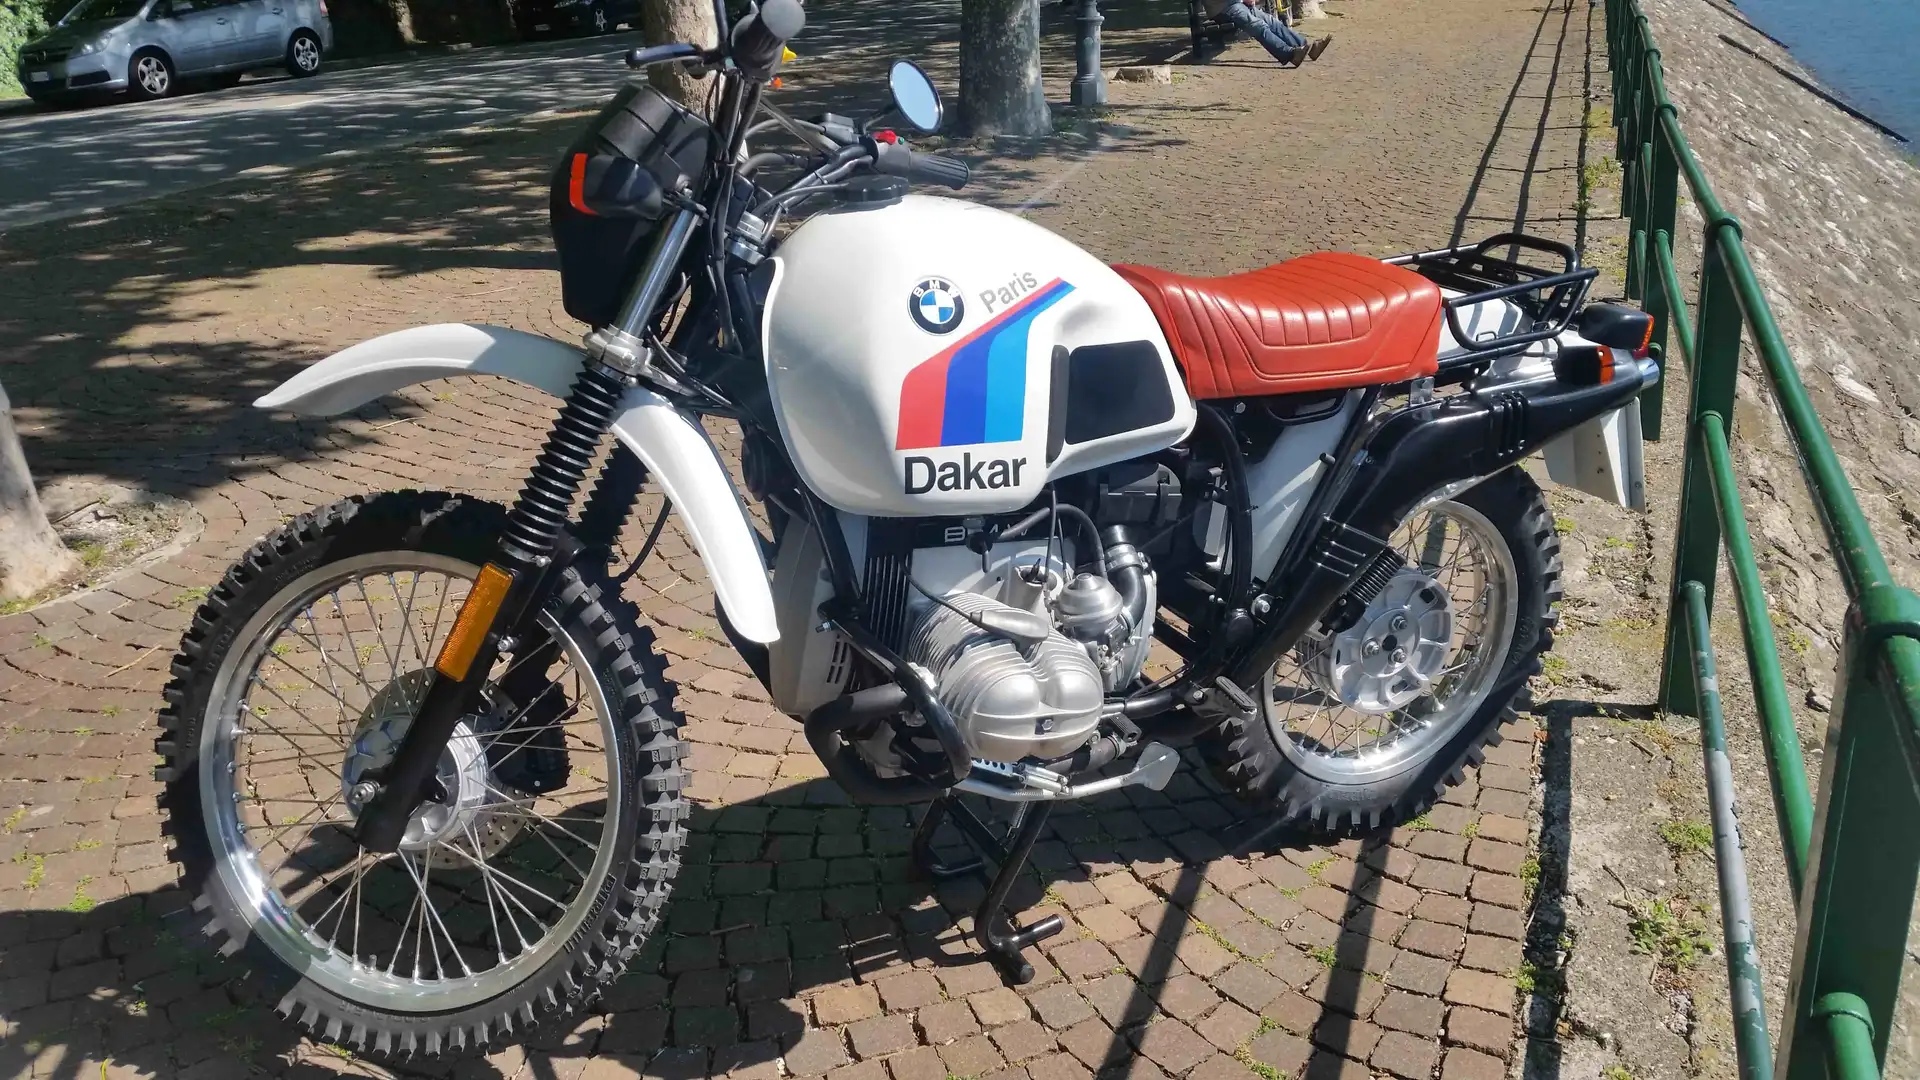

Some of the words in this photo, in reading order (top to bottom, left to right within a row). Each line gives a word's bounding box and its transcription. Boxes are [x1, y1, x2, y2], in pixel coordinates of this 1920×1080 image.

[912, 279, 961, 298] BMW
[978, 271, 1038, 314] Paris
[904, 452, 1027, 495] Dakar
